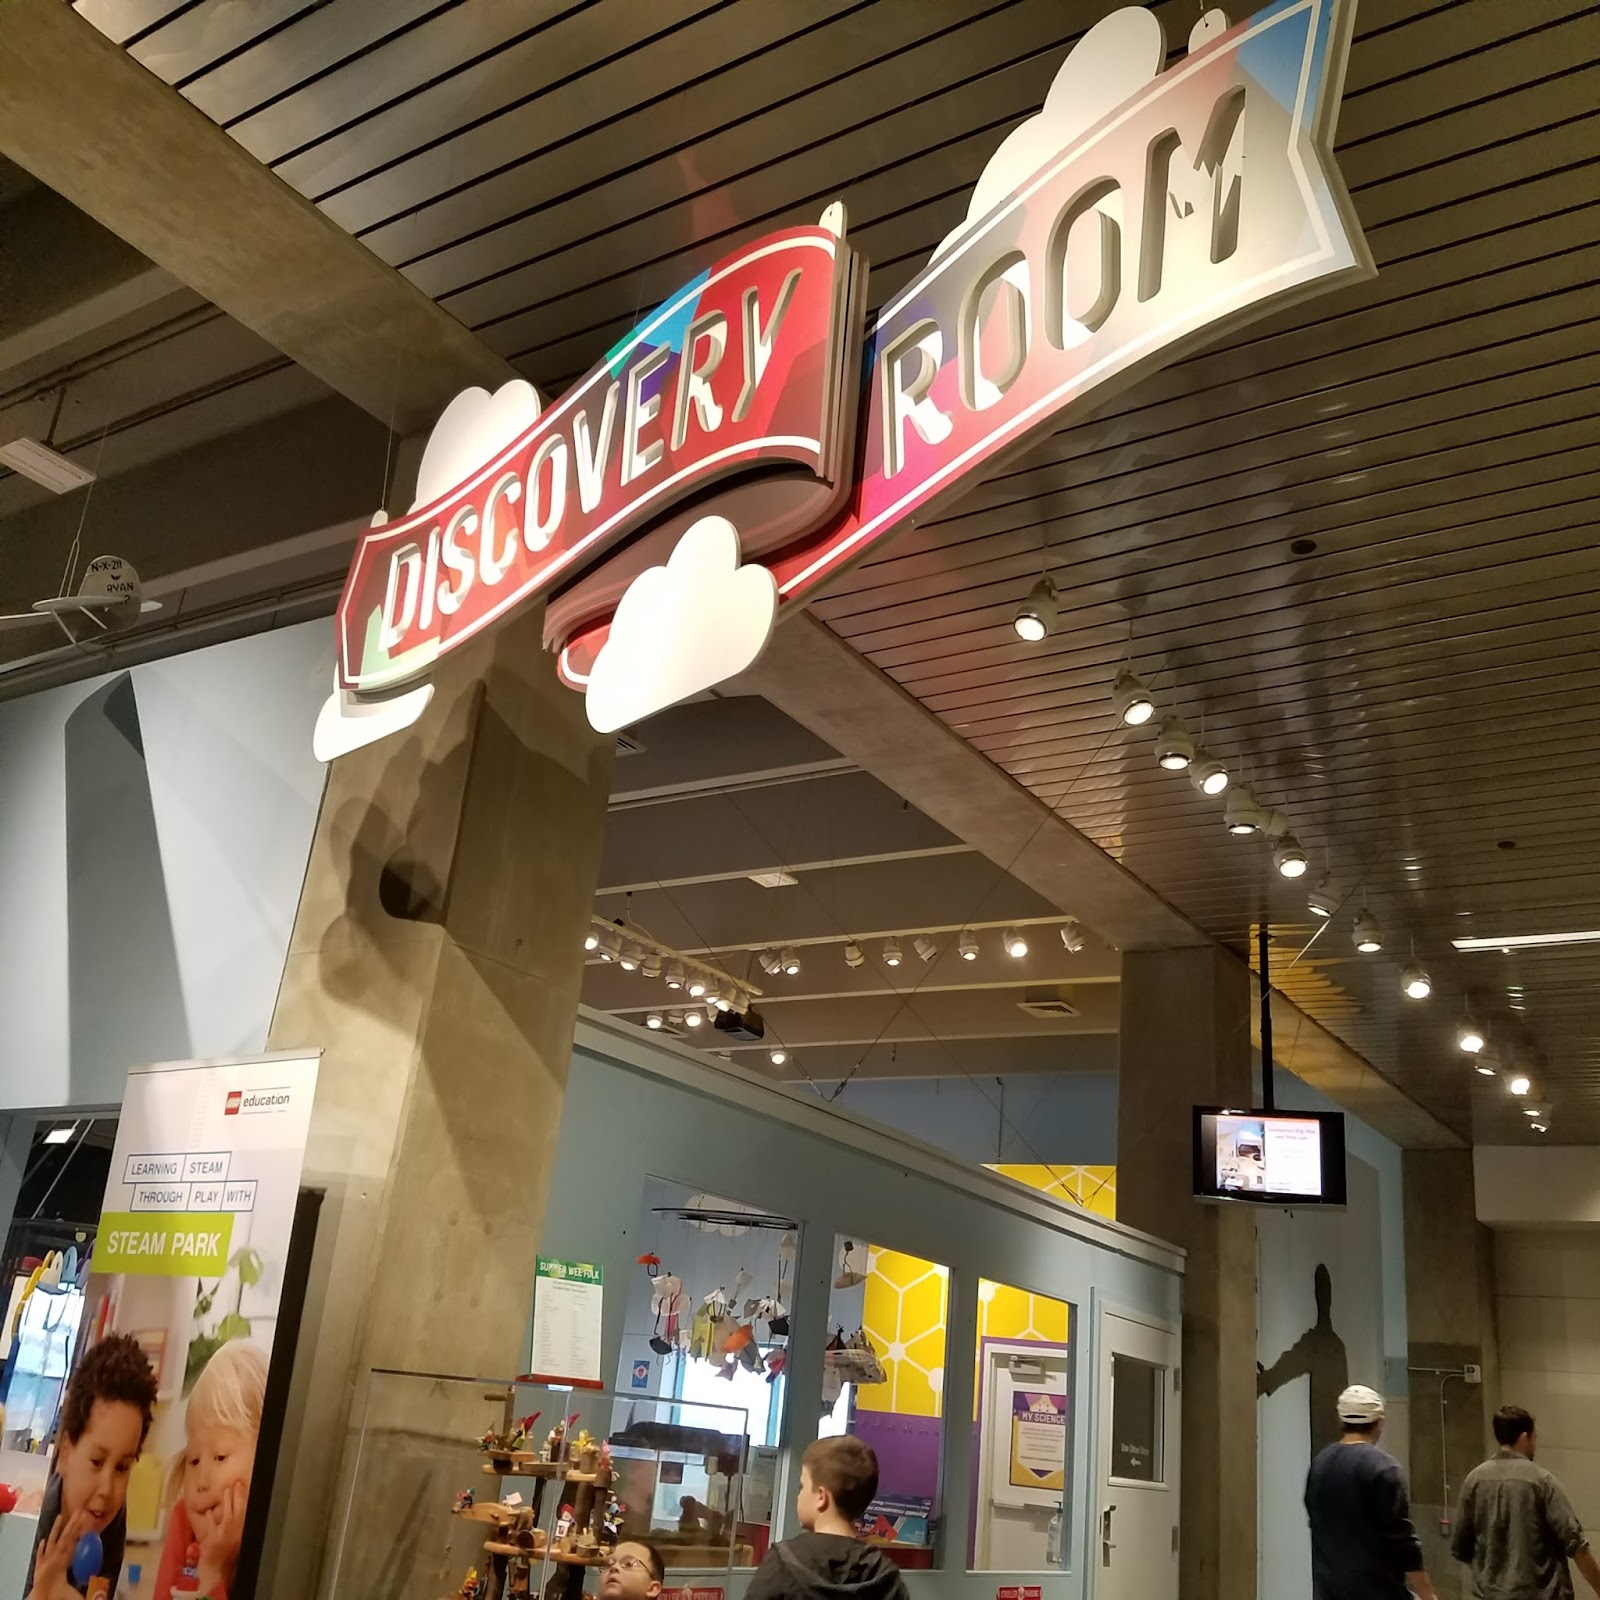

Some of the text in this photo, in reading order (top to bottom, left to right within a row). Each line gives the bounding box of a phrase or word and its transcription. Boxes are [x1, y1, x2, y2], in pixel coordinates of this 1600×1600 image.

[378, 84, 1246, 653] DISCOVERY ROOM
[91, 560, 123, 572] N-X-211
[106, 582, 134, 593] RYAN
[243, 1093, 290, 1107] education
[131, 1161, 223, 1176] LEARNING STEAM
[139, 1189, 252, 1203] THROUGH PLAY WITH
[107, 1231, 222, 1257] STEAM PARK
[540, 1261, 600, 1280] SUMMER WEE FOLK
[1022, 1412, 1065, 1424] MY SCIENCE
